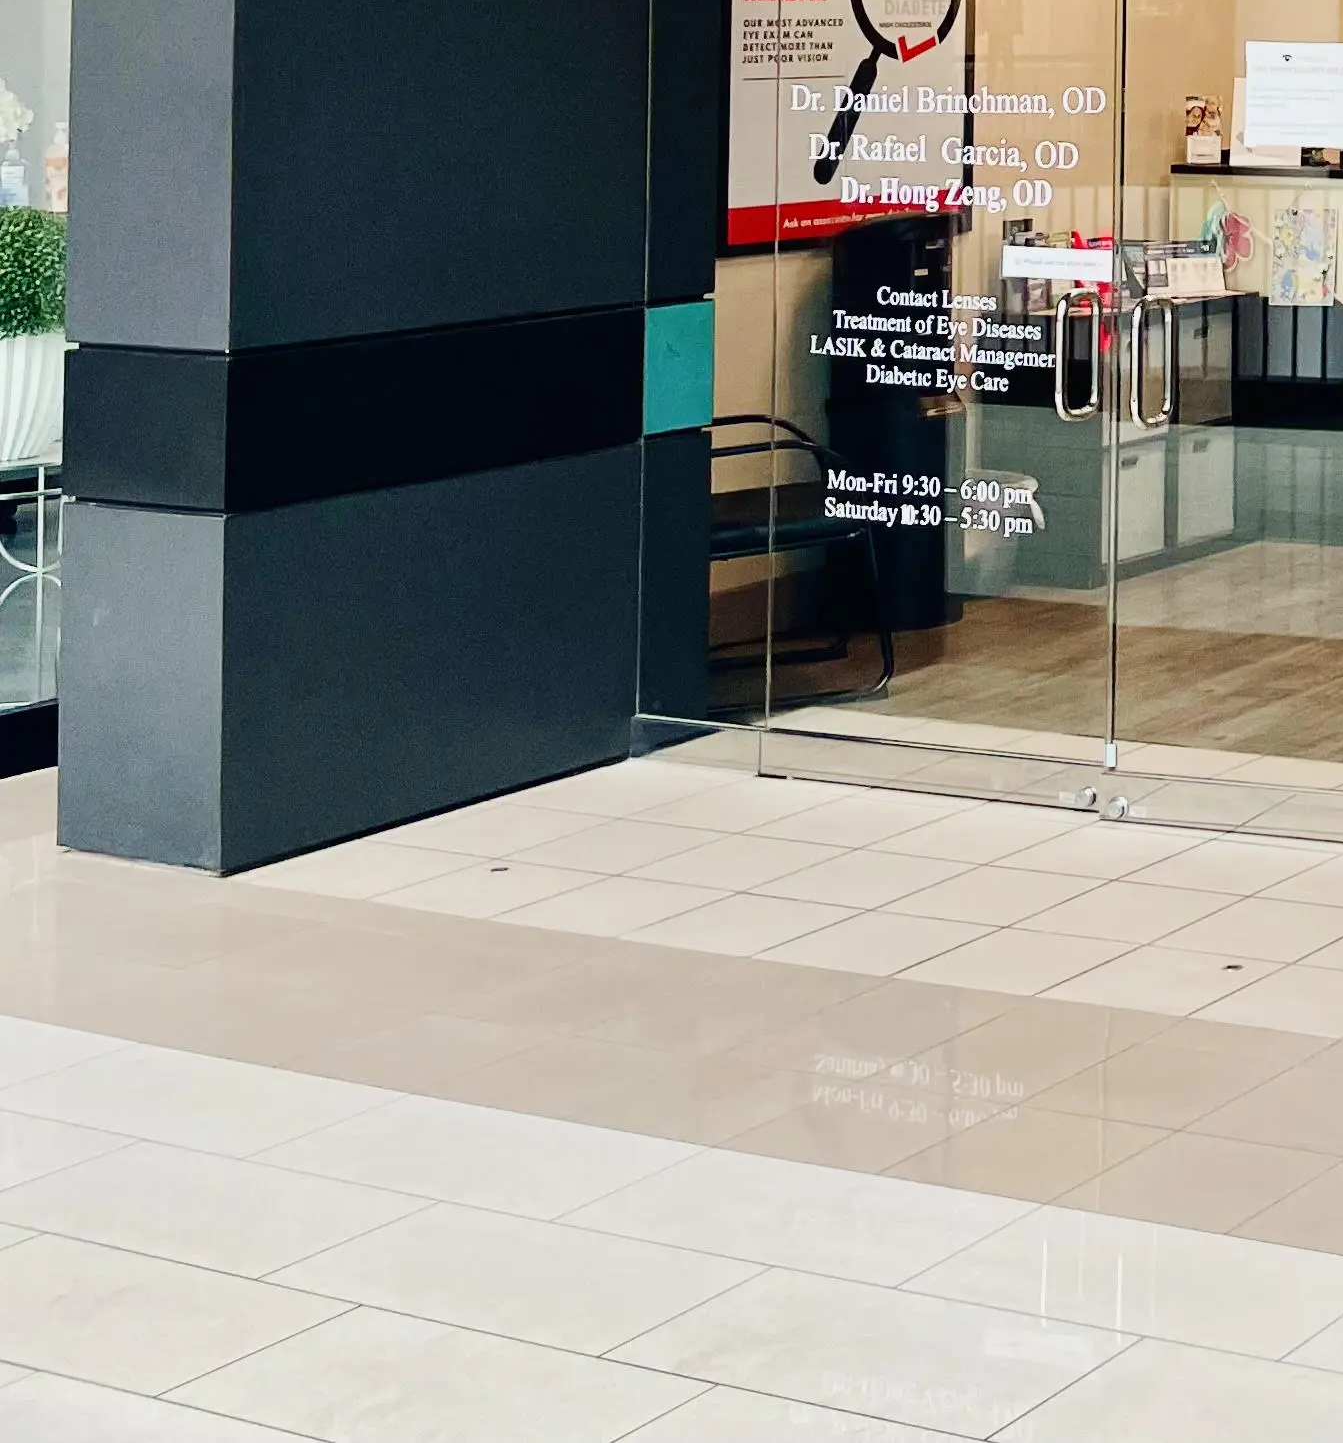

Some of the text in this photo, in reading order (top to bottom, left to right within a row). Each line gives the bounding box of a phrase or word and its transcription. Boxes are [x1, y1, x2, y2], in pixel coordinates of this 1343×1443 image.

[743, 19, 763, 28] OUR
[796, 18, 844, 27] ADVANCED
[743, 30, 813, 40] EYE EXM CAN
[742, 42, 776, 52] DETECT
[810, 41, 833, 50] THAN
[742, 54, 764, 64] JUST
[790, 84, 1107, 118] Dr. Daniel Brinchman, OD
[808, 133, 1079, 172] Dr. Rafael Garcia, OD
[840, 176, 873, 205] Dr.
[880, 177, 939, 212] Hong
[944, 178, 1007, 213] Zeng,
[1012, 179, 1053, 207] OD
[876, 286, 998, 311] Contact Lenses
[832, 309, 1042, 341] Treatment of Eye Diseases
[810, 335, 1056, 371] LASIK & Cataract Managemen
[866, 364, 1010, 394] Diabetic Eye Care
[826, 468, 898, 495] Mon-Fri
[902, 474, 941, 497] 9:30
[960, 478, 1001, 502] 6:00
[1003, 487, 1034, 508] pm
[824, 496, 898, 527] Saturday
[959, 507, 1001, 531] 5:30
[1003, 516, 1034, 538] pm
